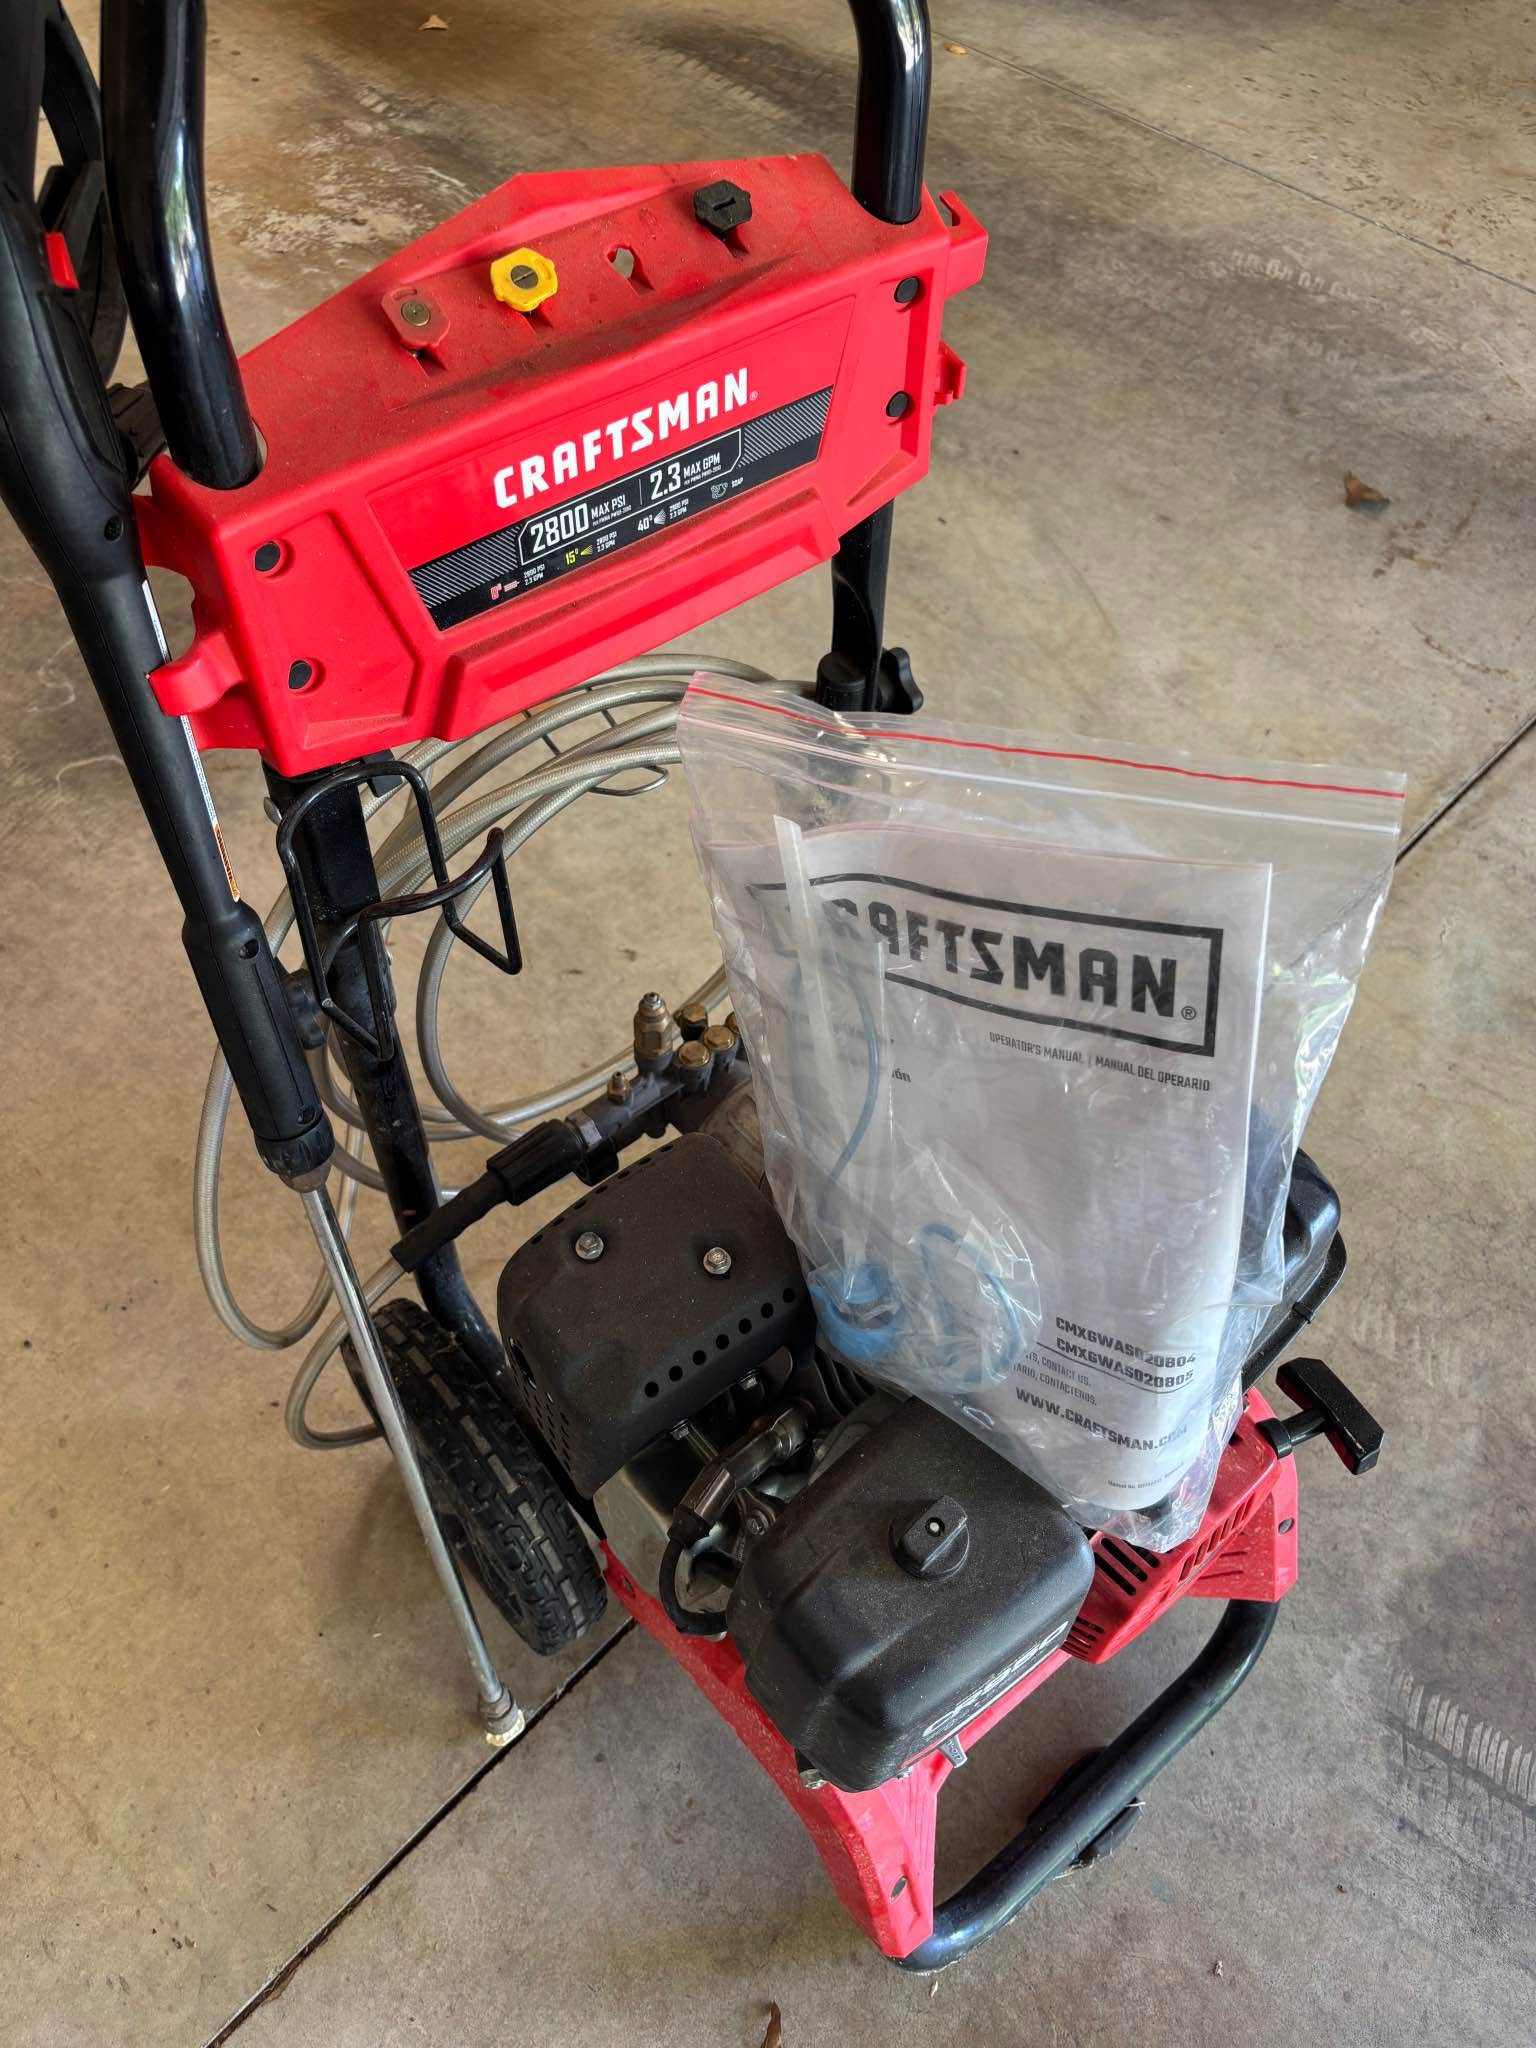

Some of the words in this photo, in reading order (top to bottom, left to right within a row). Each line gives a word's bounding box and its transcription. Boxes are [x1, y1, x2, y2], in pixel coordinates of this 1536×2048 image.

[650, 462, 681, 500] 2.3
[683, 460, 701, 479] MAX
[702, 452, 720, 470] GPM
[731, 477, 744, 488] SOAP
[681, 498, 689, 507] PSI
[669, 511, 677, 519] 2.3
[677, 506, 687, 516] GPM
[530, 503, 590, 554] 2800
[591, 504, 610, 520] MAX
[611, 494, 626, 511] PSI
[608, 531, 617, 541] PSI
[597, 543, 605, 553] 2.3
[604, 539, 616, 550] GPM
[536, 563, 545, 573] PSI
[524, 576, 534, 586] 2.3
[533, 572, 544, 583] GPM
[989, 1031, 1041, 1056] OPERATOR'S
[1043, 1045, 1084, 1063] MANUAL
[1095, 1056, 1135, 1076] MANUAL
[1137, 1065, 1155, 1081] DEL
[1157, 1071, 1211, 1092] OPERARIO
[1041, 1356, 1075, 1381] CONTACT
